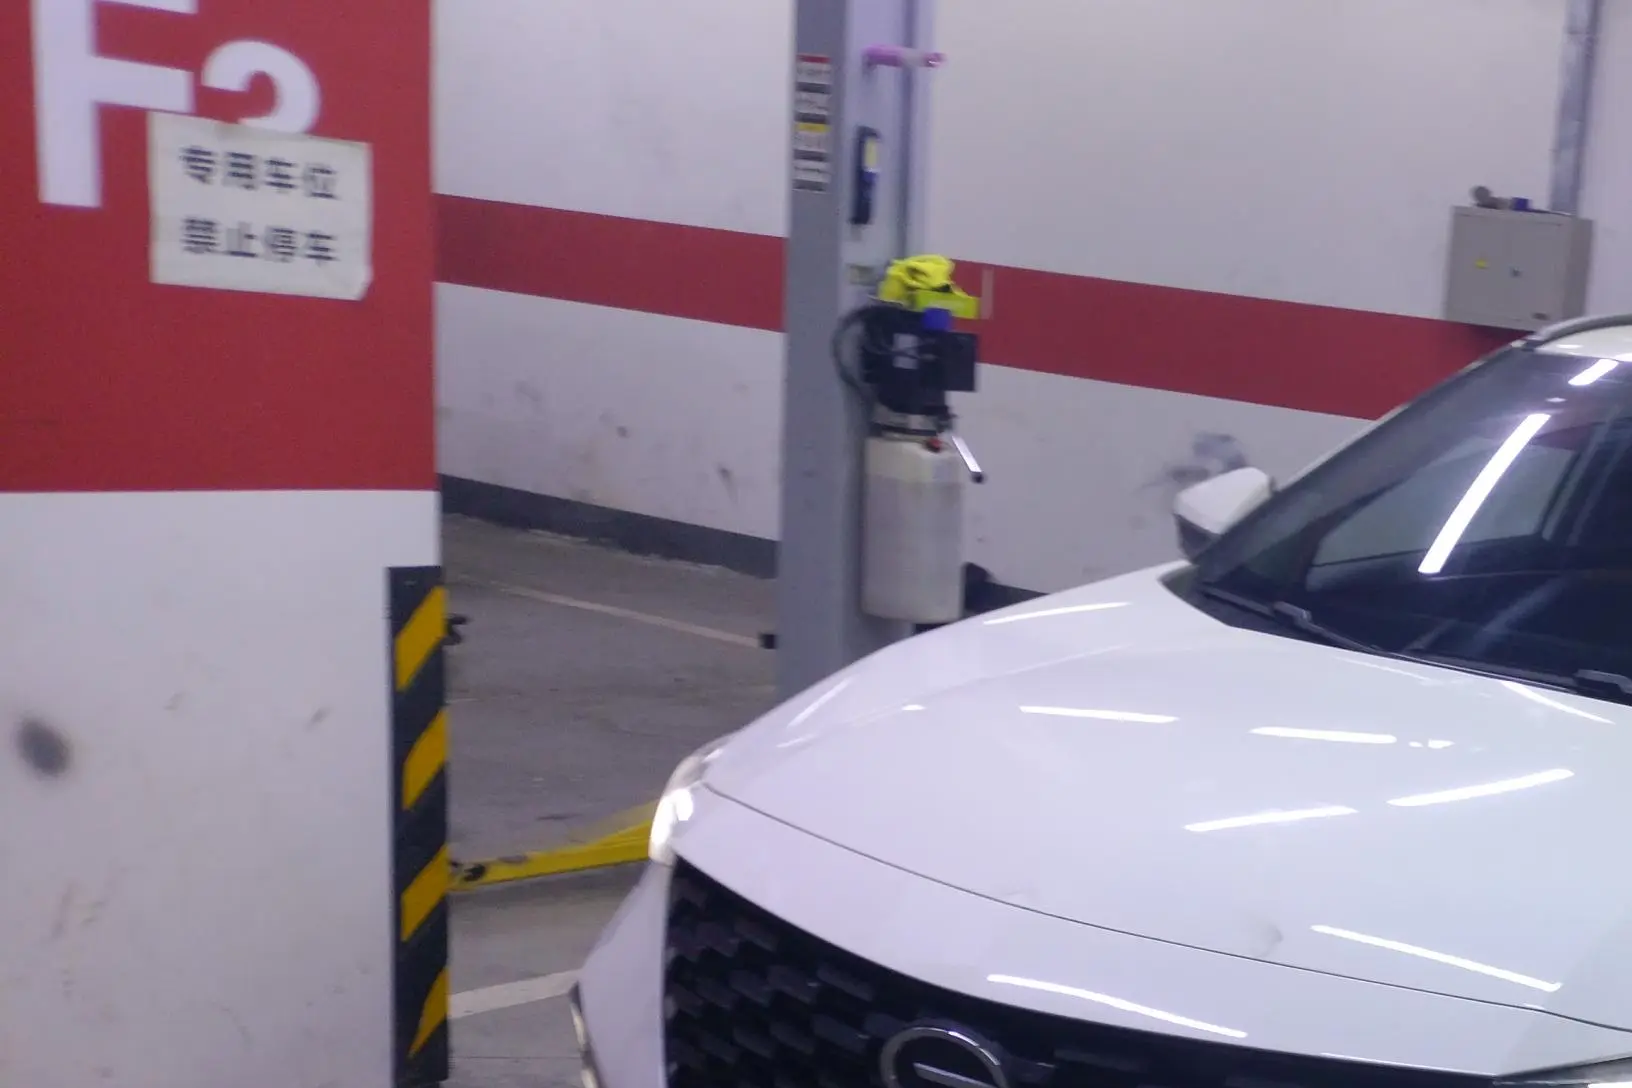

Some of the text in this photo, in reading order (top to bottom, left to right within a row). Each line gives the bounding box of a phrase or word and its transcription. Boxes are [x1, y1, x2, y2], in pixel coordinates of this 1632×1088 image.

[180, 145, 340, 200] 专用车位
[181, 217, 340, 266] 禁止停车
